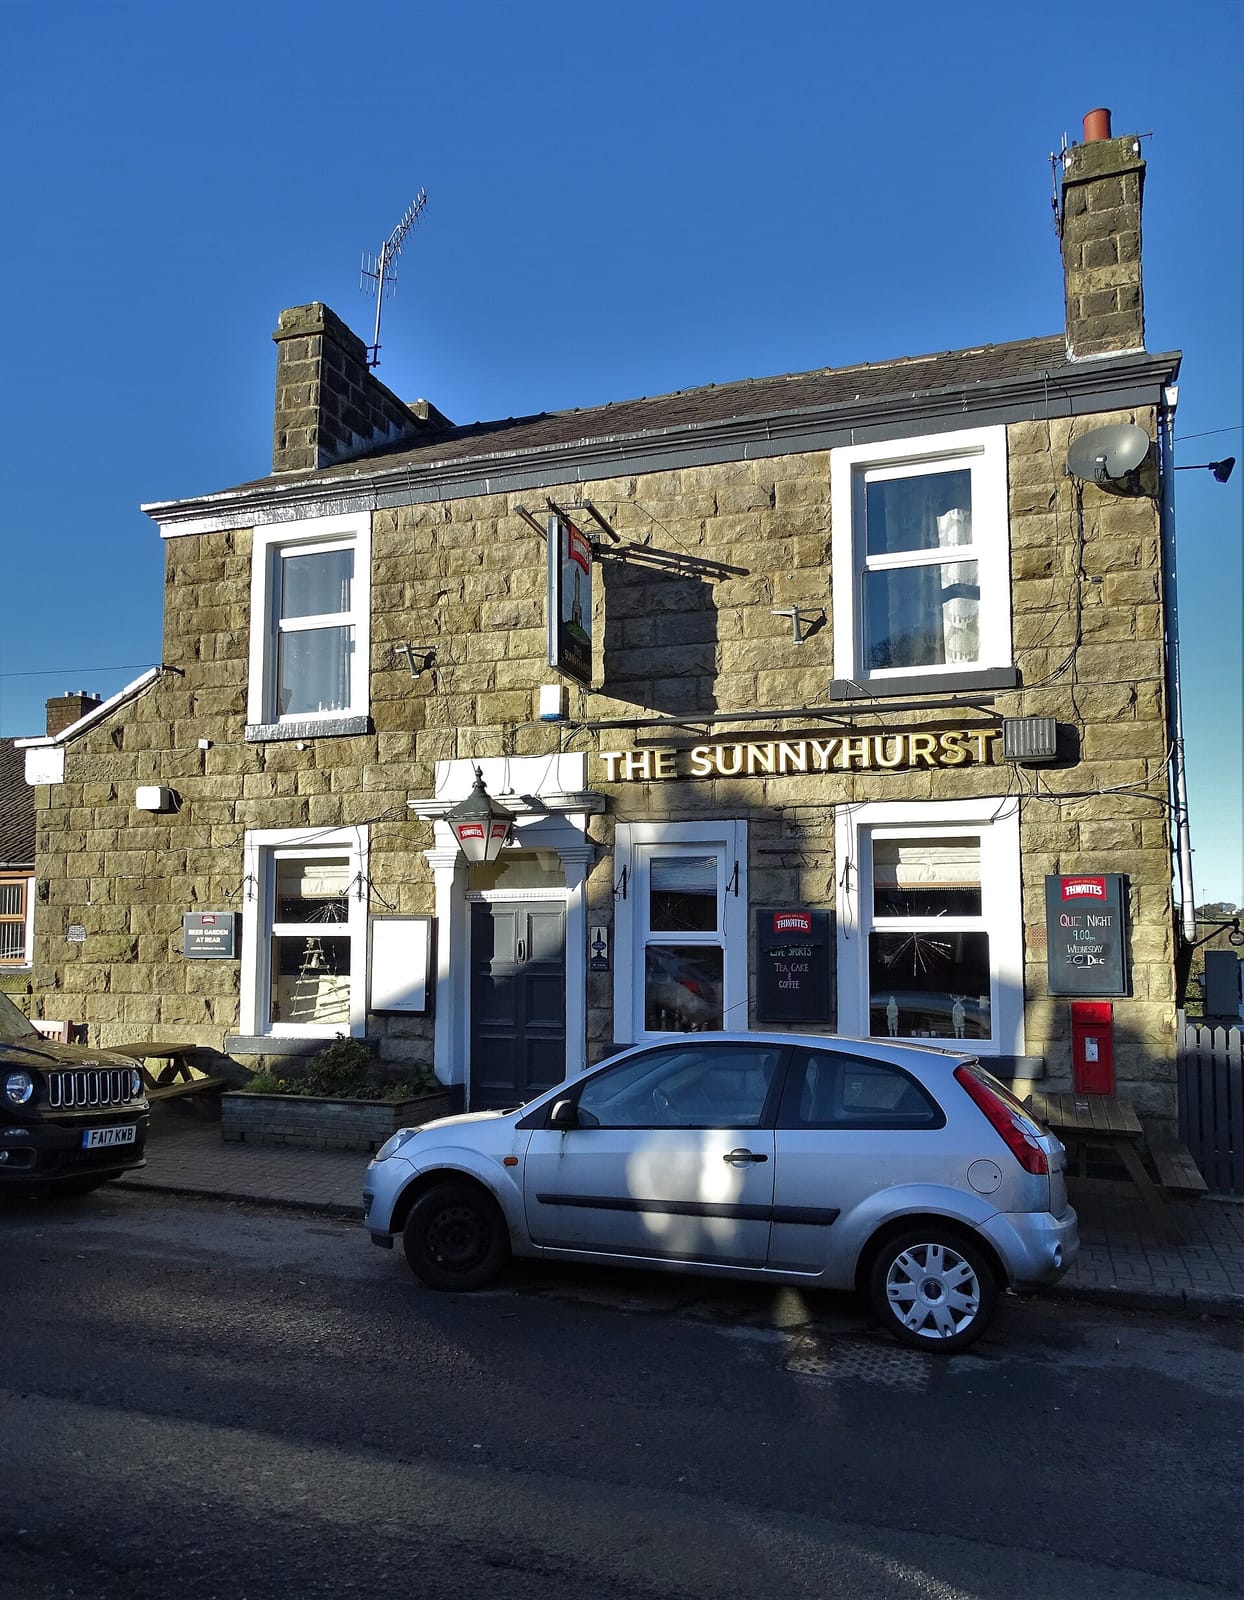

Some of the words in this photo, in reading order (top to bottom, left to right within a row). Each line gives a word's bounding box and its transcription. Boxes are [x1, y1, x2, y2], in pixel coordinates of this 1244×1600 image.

[600, 750, 678, 782] THE
[690, 730, 997, 777] SUNNYHURST
[1065, 884, 1102, 896] THWAITES
[777, 919, 808, 929] THWAITES
[1060, 914, 1081, 927] QUIZ
[1087, 915, 1112, 927] NIGHT
[1067, 944, 1104, 954] WEDNESDAY
[91, 1130, 113, 1144] FA17
[115, 1127, 133, 1141] KWB
